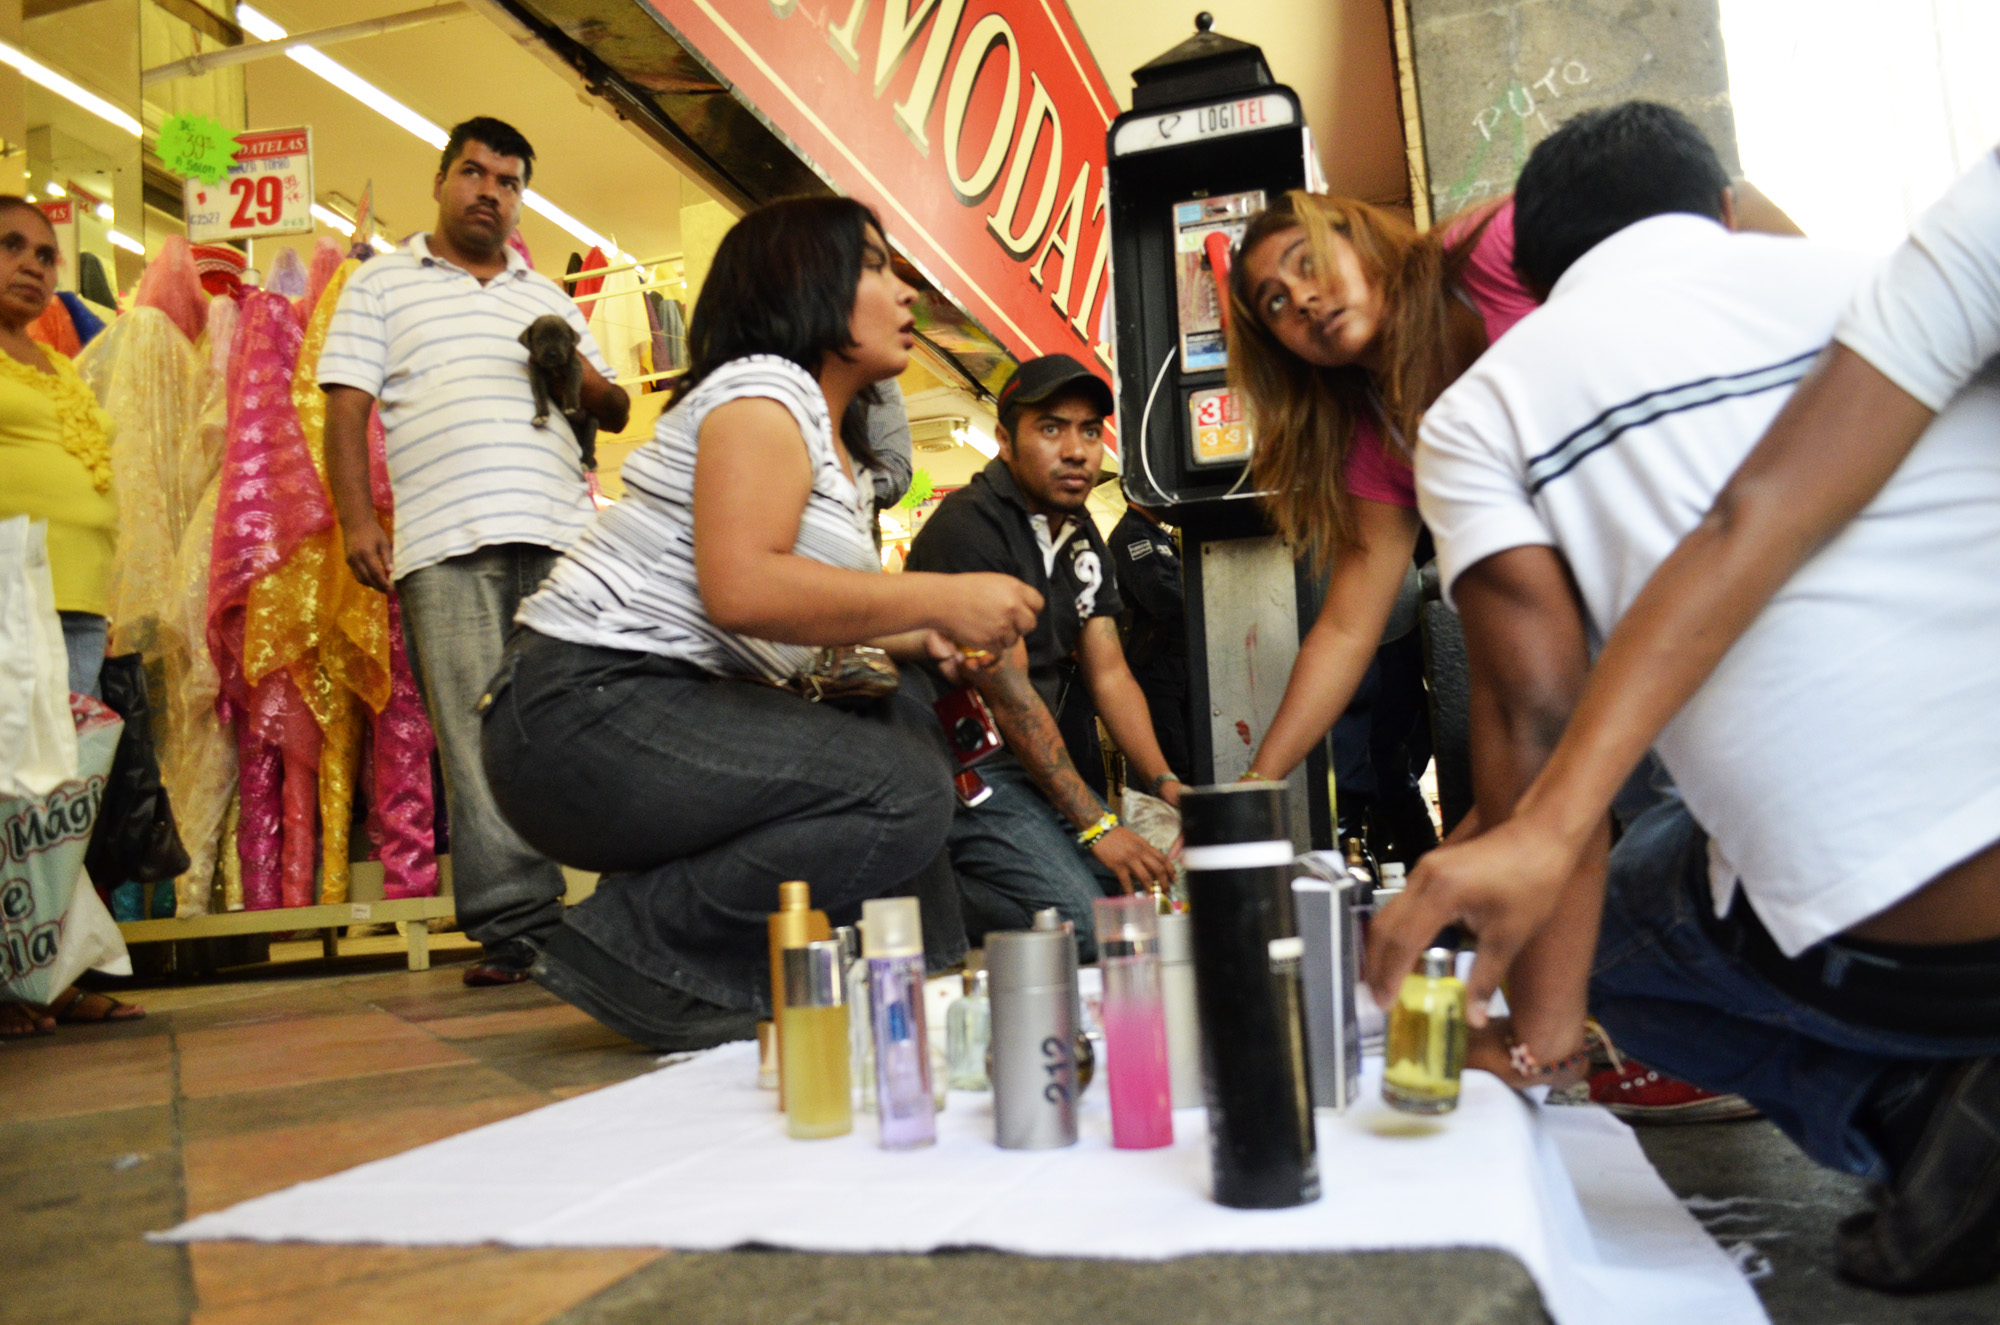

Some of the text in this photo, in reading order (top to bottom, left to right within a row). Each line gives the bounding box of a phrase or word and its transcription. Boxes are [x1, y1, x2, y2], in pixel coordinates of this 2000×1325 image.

[1198, 99, 1267, 133] LOGITEL
[1473, 60, 1592, 141] PUTO
[239, 138, 304, 157] DATELAS
[48, 206, 68, 220] AS
[230, 175, 283, 229] 29
[828, 0, 1115, 370] MODAT
[11, 780, 101, 858] Mági
[1042, 1037, 1074, 1105] 212
